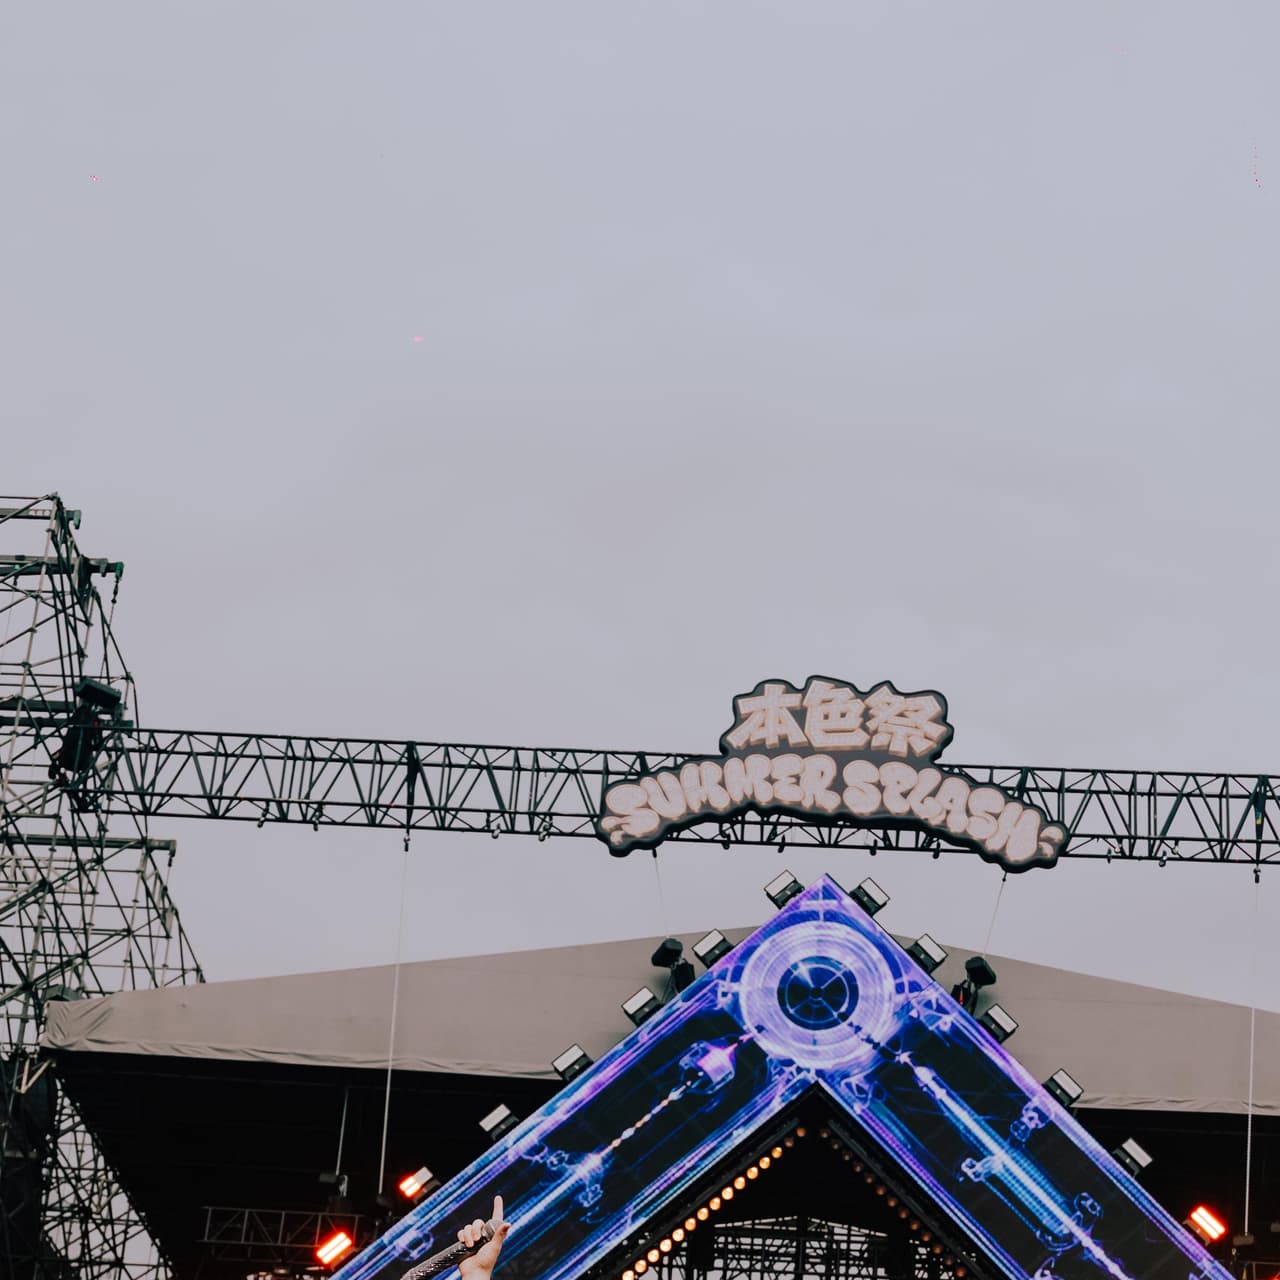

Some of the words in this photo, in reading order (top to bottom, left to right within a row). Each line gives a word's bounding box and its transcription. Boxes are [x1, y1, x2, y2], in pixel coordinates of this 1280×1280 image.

[726, 679, 948, 757] 本色祭
[602, 754, 841, 842] SUMMER
[843, 760, 1050, 862] SPLASH
